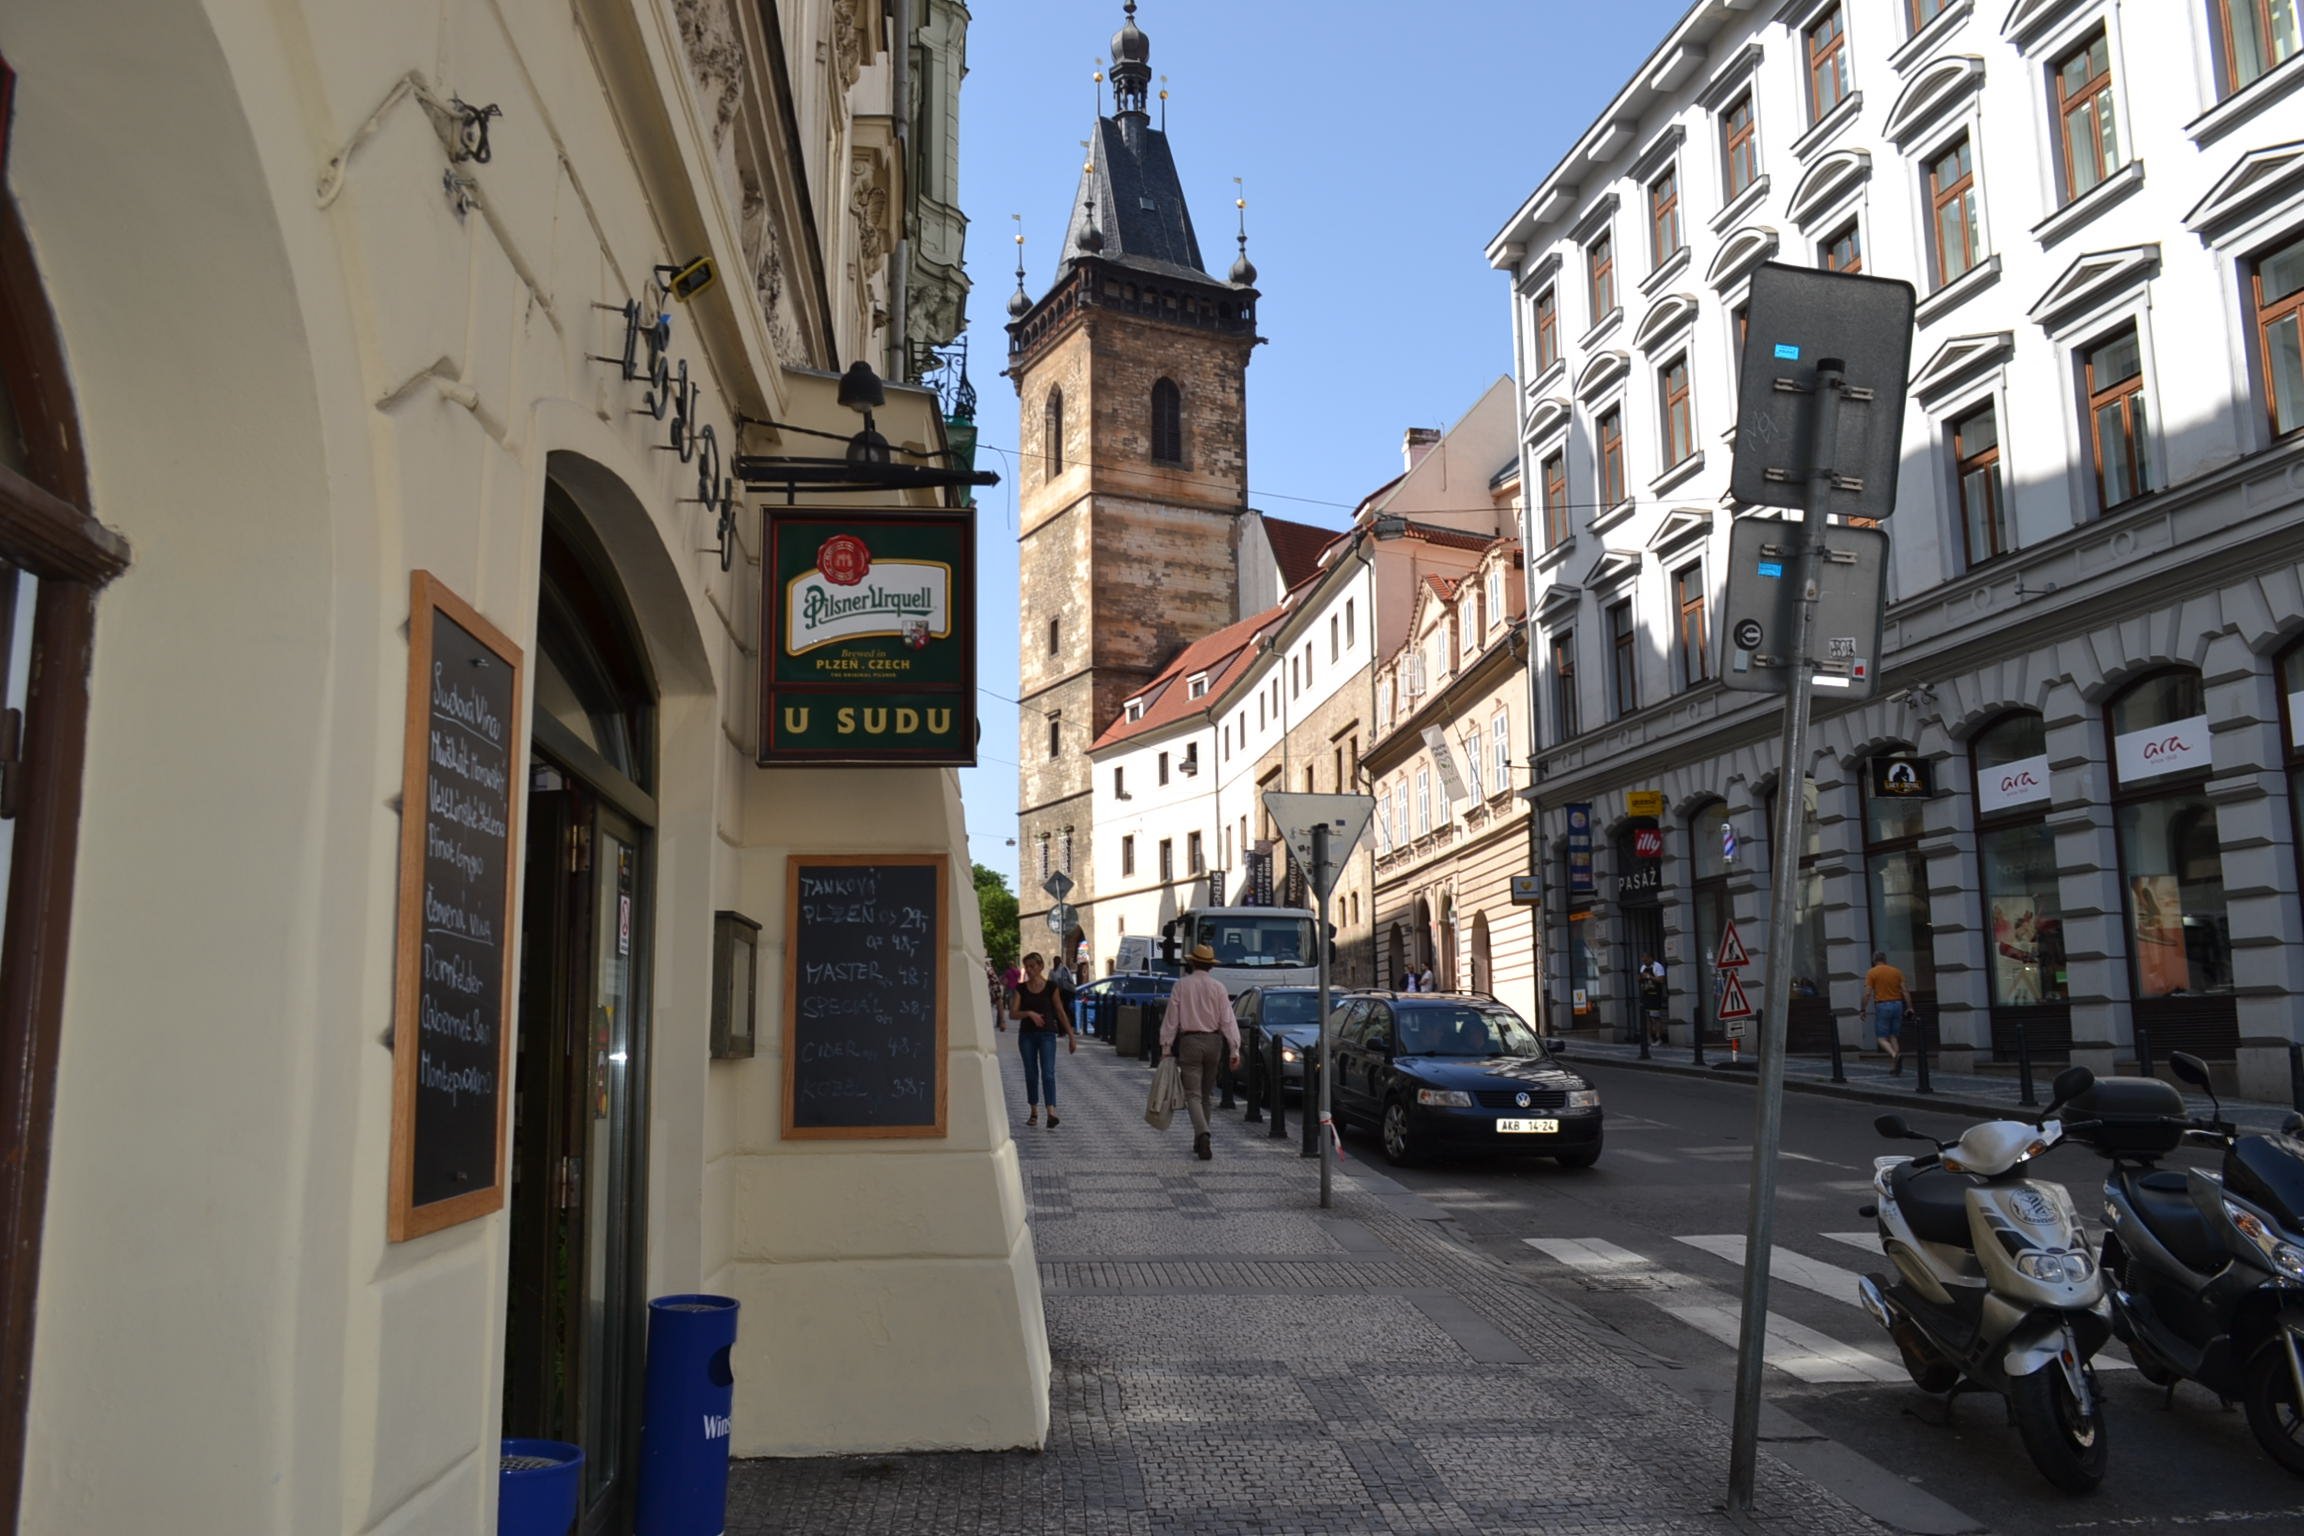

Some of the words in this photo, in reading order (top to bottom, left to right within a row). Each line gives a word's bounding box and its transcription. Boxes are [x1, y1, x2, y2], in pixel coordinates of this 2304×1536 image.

[803, 585, 869, 630] Pilsner
[868, 584, 931, 617] Urquell
[841, 648, 874, 657] Brewed
[876, 648, 886, 657] in
[816, 658, 858, 670] PLZEŇ
[868, 659, 910, 670] CZECH
[784, 707, 810, 734] U
[837, 707, 951, 735] SUDU
[2143, 736, 2190, 759] ara
[2001, 771, 2039, 792] ara
[1637, 833, 1661, 854] illy
[1618, 866, 1657, 893] PASÁŽ
[806, 960, 883, 984] MASTER
[1501, 1120, 1520, 1131] AKB
[1528, 1120, 1554, 1131] 14-24
